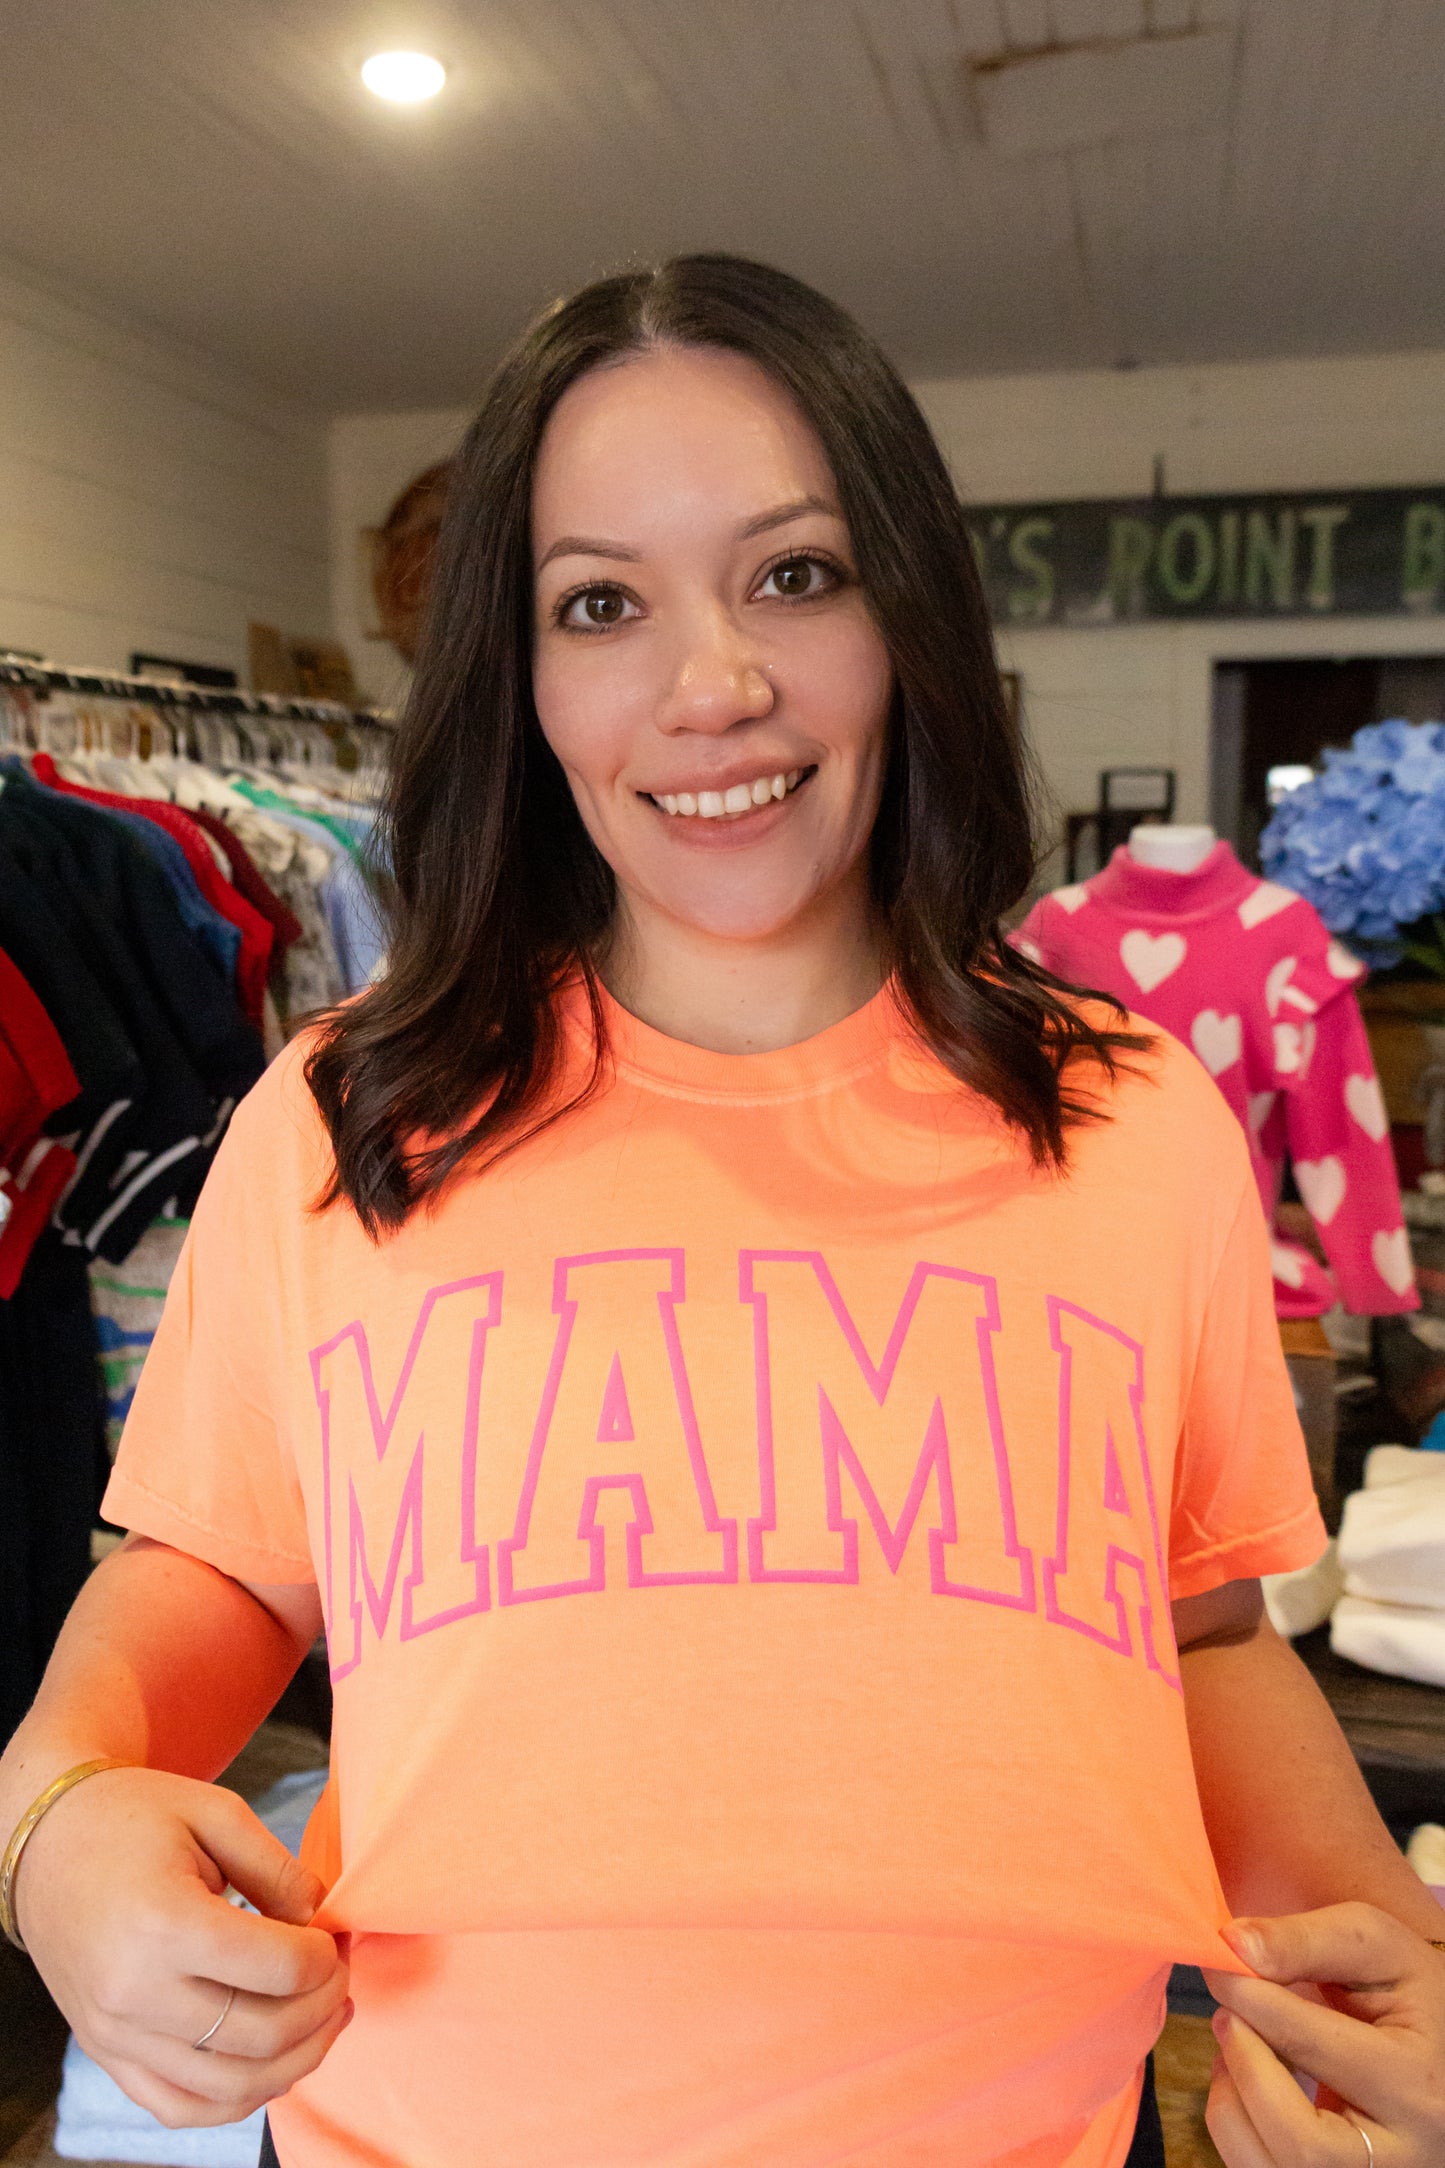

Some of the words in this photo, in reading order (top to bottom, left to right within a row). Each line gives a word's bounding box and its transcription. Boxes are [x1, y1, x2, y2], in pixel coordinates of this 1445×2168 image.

[971, 516, 1055, 617] 'S
[1107, 505, 1351, 615] POINT
[308, 1247, 1185, 1699] MAMA
